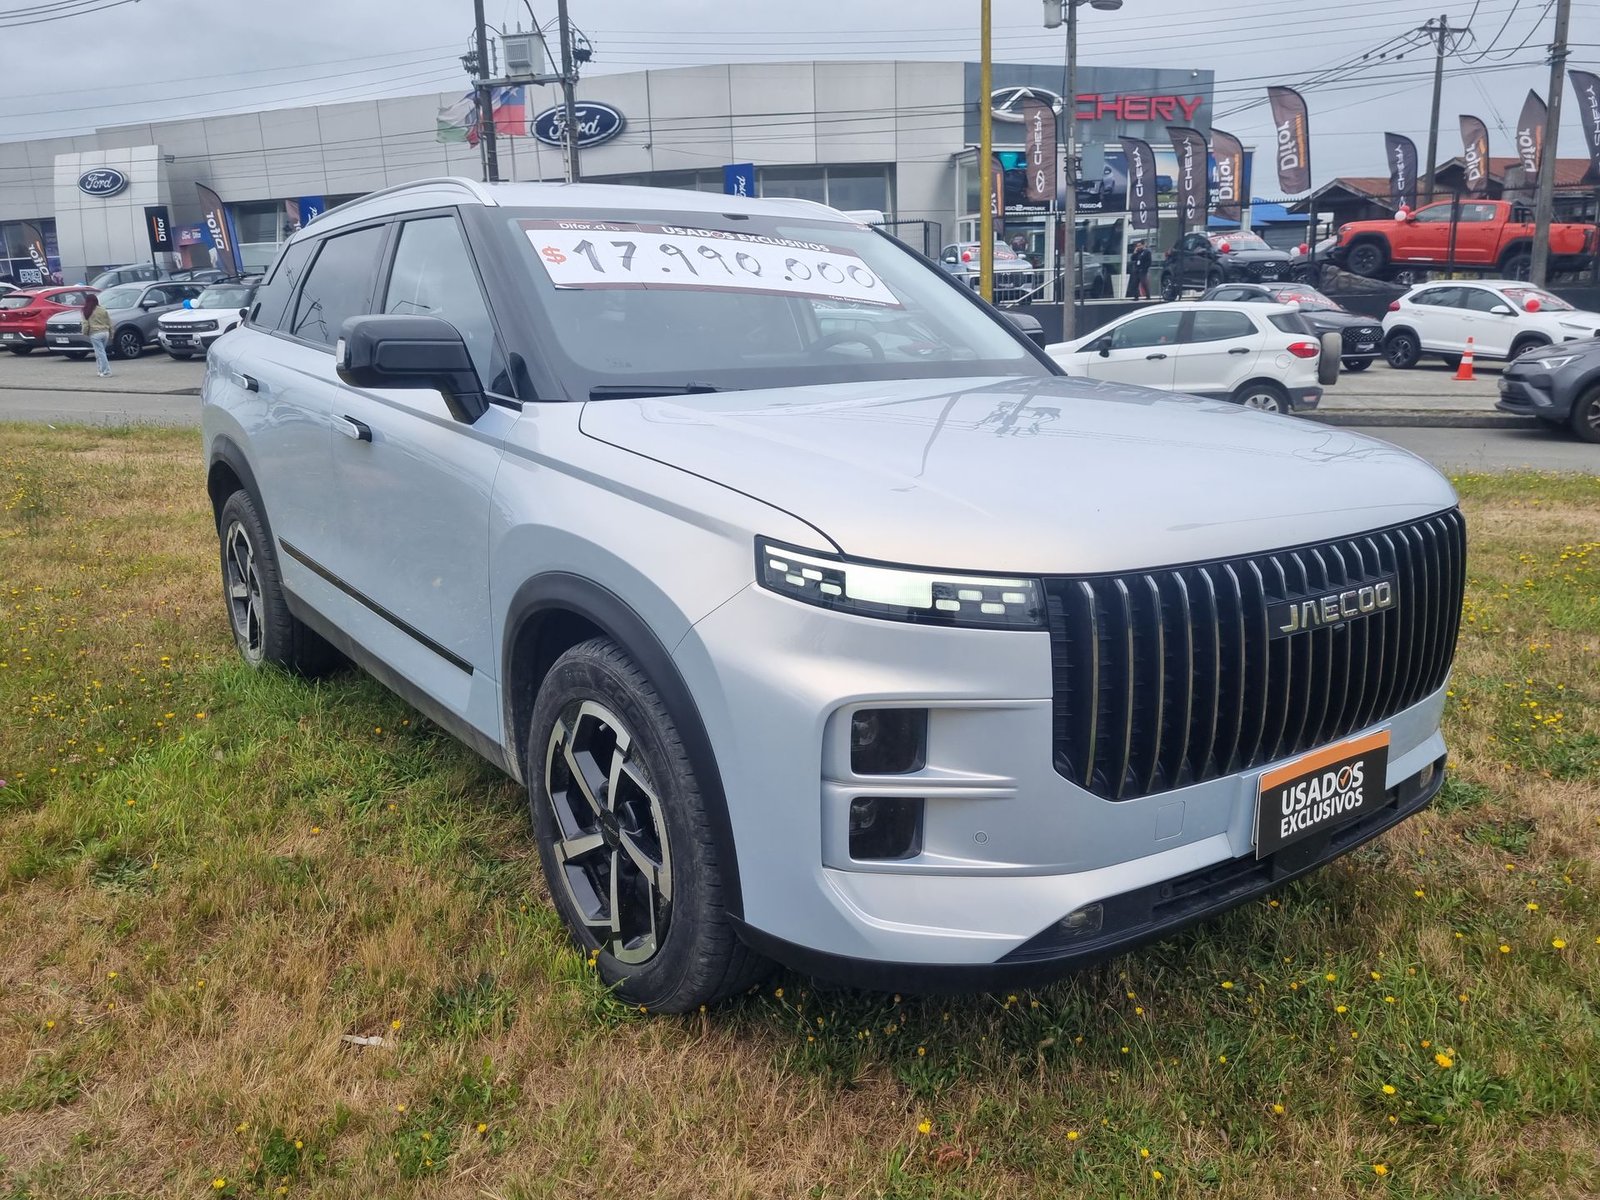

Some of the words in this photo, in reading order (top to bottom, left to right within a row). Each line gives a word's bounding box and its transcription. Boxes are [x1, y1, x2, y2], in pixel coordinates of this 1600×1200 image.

[1074, 94, 1203, 121] CHERY
[549, 111, 600, 139] Frd
[85, 173, 113, 189] Ford
[157, 217, 167, 242] Difor
[661, 226, 735, 240] USADOS
[739, 233, 831, 253] EXCLUSIVOS
[1280, 581, 1392, 633] JAECOO
[1281, 760, 1365, 816] USADOS
[1280, 786, 1364, 839] EXCLUSIVOS
